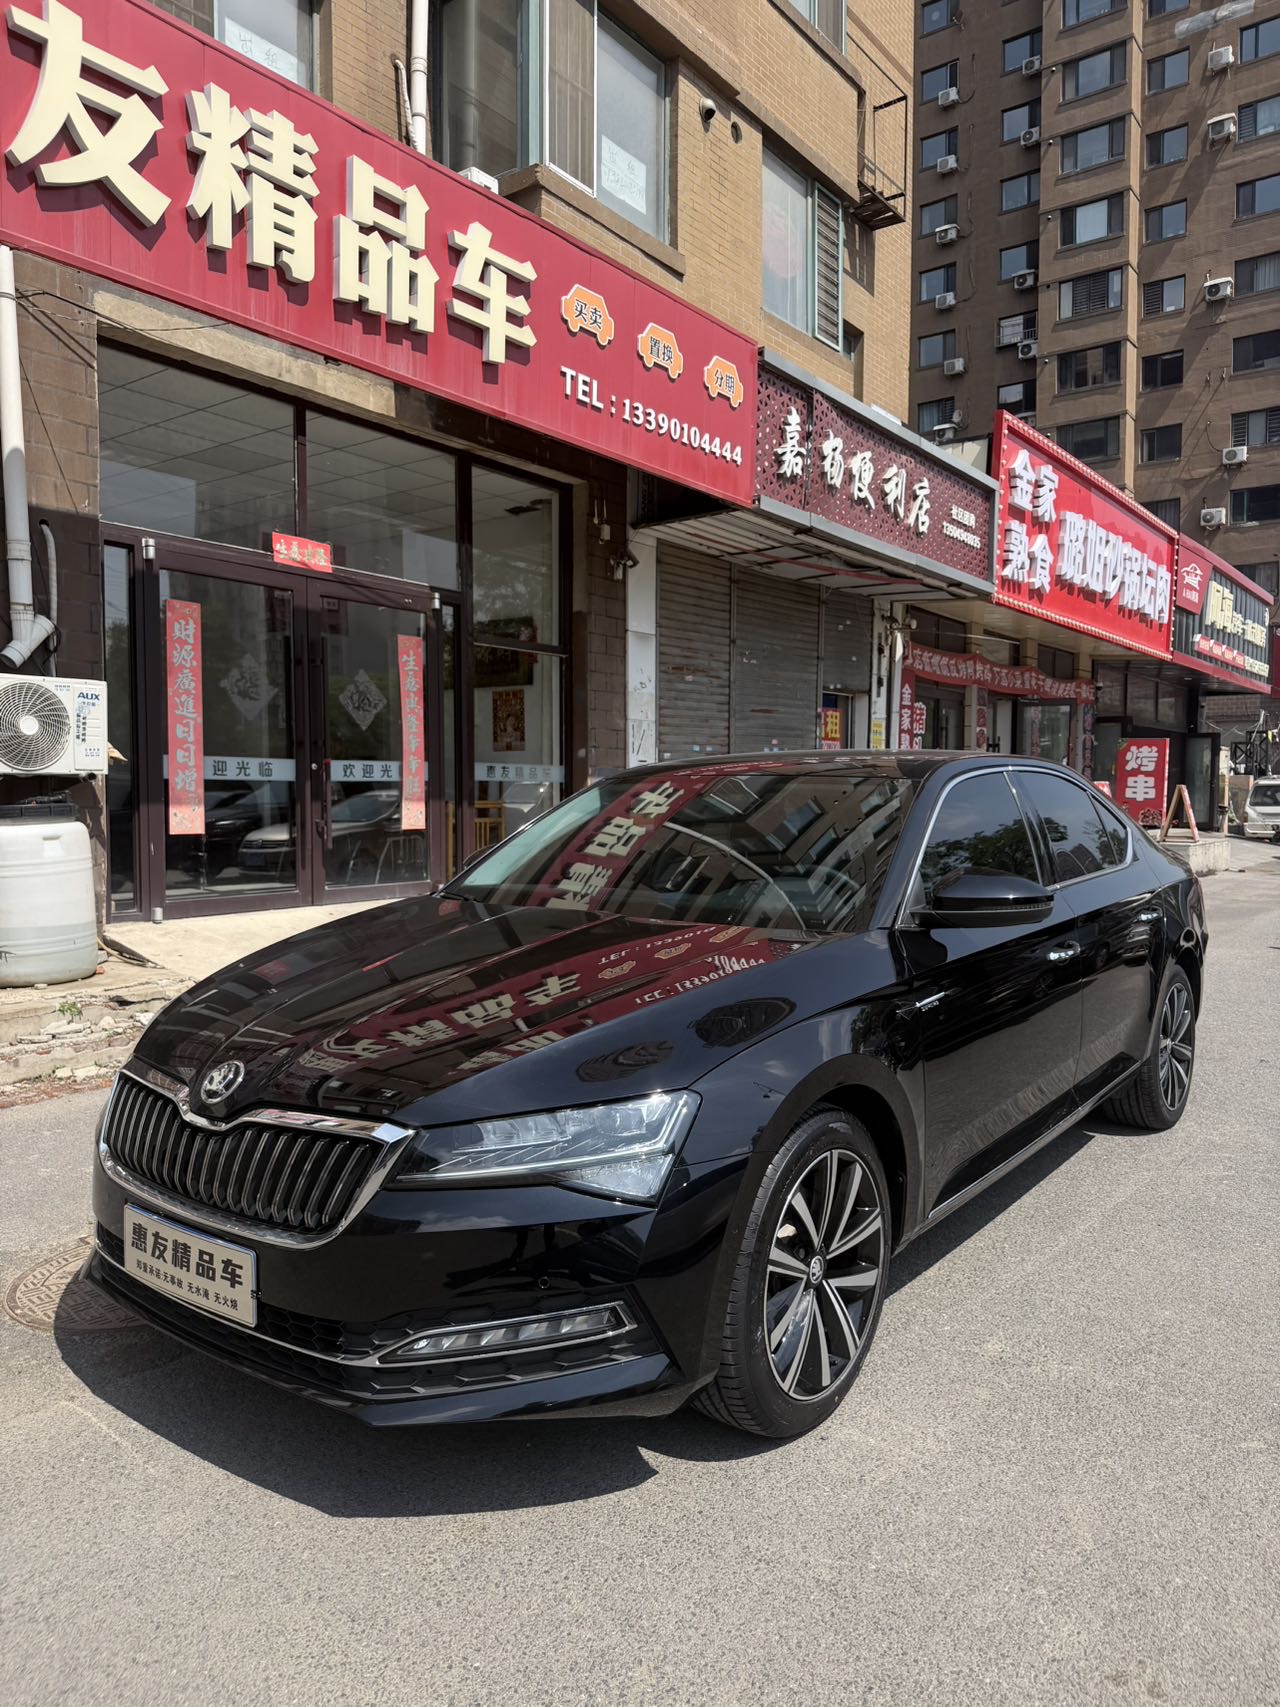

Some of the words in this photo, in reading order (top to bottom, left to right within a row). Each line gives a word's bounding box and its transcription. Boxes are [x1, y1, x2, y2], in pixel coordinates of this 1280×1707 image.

[4, 0, 537, 364] 友精品车
[574, 298, 603, 330] 买卖
[649, 337, 674, 364] 置换
[713, 368, 735, 394] 分期
[1008, 449, 1059, 522] 金家
[1001, 520, 1054, 593] 熟食
[77, 691, 100, 701] AUX
[1124, 745, 1159, 802] 烤串
[131, 1221, 244, 1290] 惠友精品车
